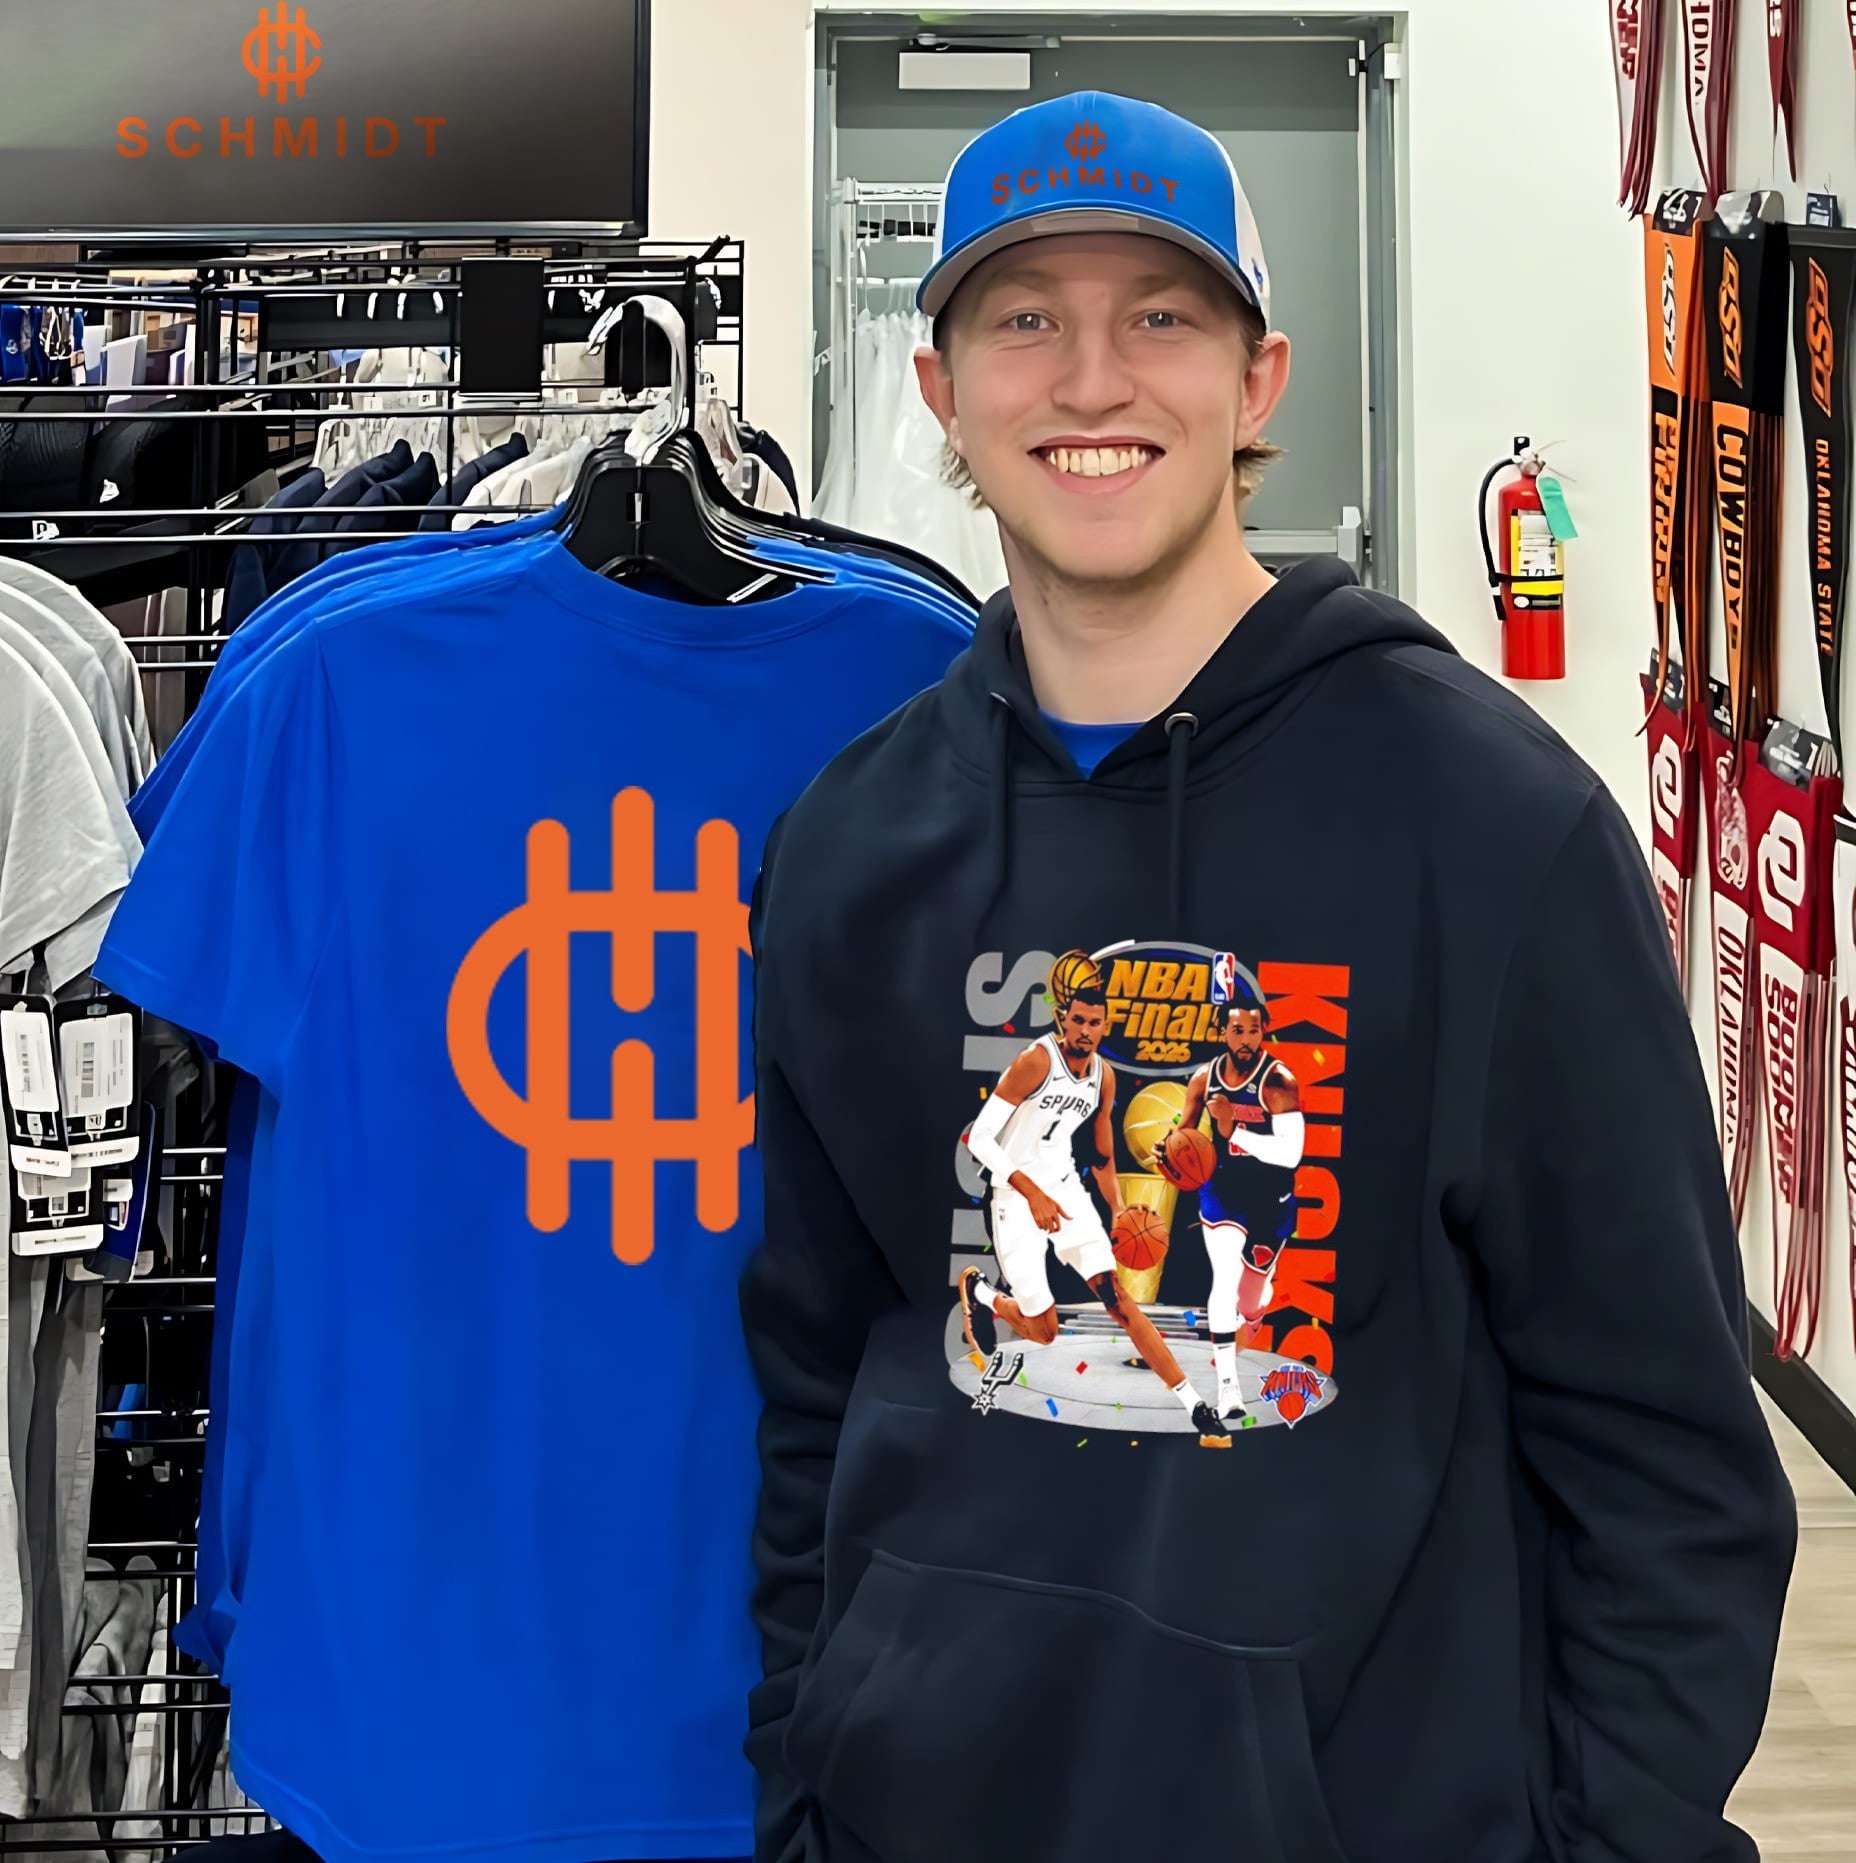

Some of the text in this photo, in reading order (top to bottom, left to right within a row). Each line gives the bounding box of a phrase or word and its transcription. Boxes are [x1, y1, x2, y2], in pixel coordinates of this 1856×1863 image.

[116, 116, 448, 159] SCHMIDT
[990, 165, 1180, 205] SCHMIDT
[1105, 959, 1210, 1002] NBA
[1135, 1040, 1191, 1063] 2026
[1718, 926, 1746, 1144] OKLAHOMA
[1041, 1119, 1061, 1141] 1
